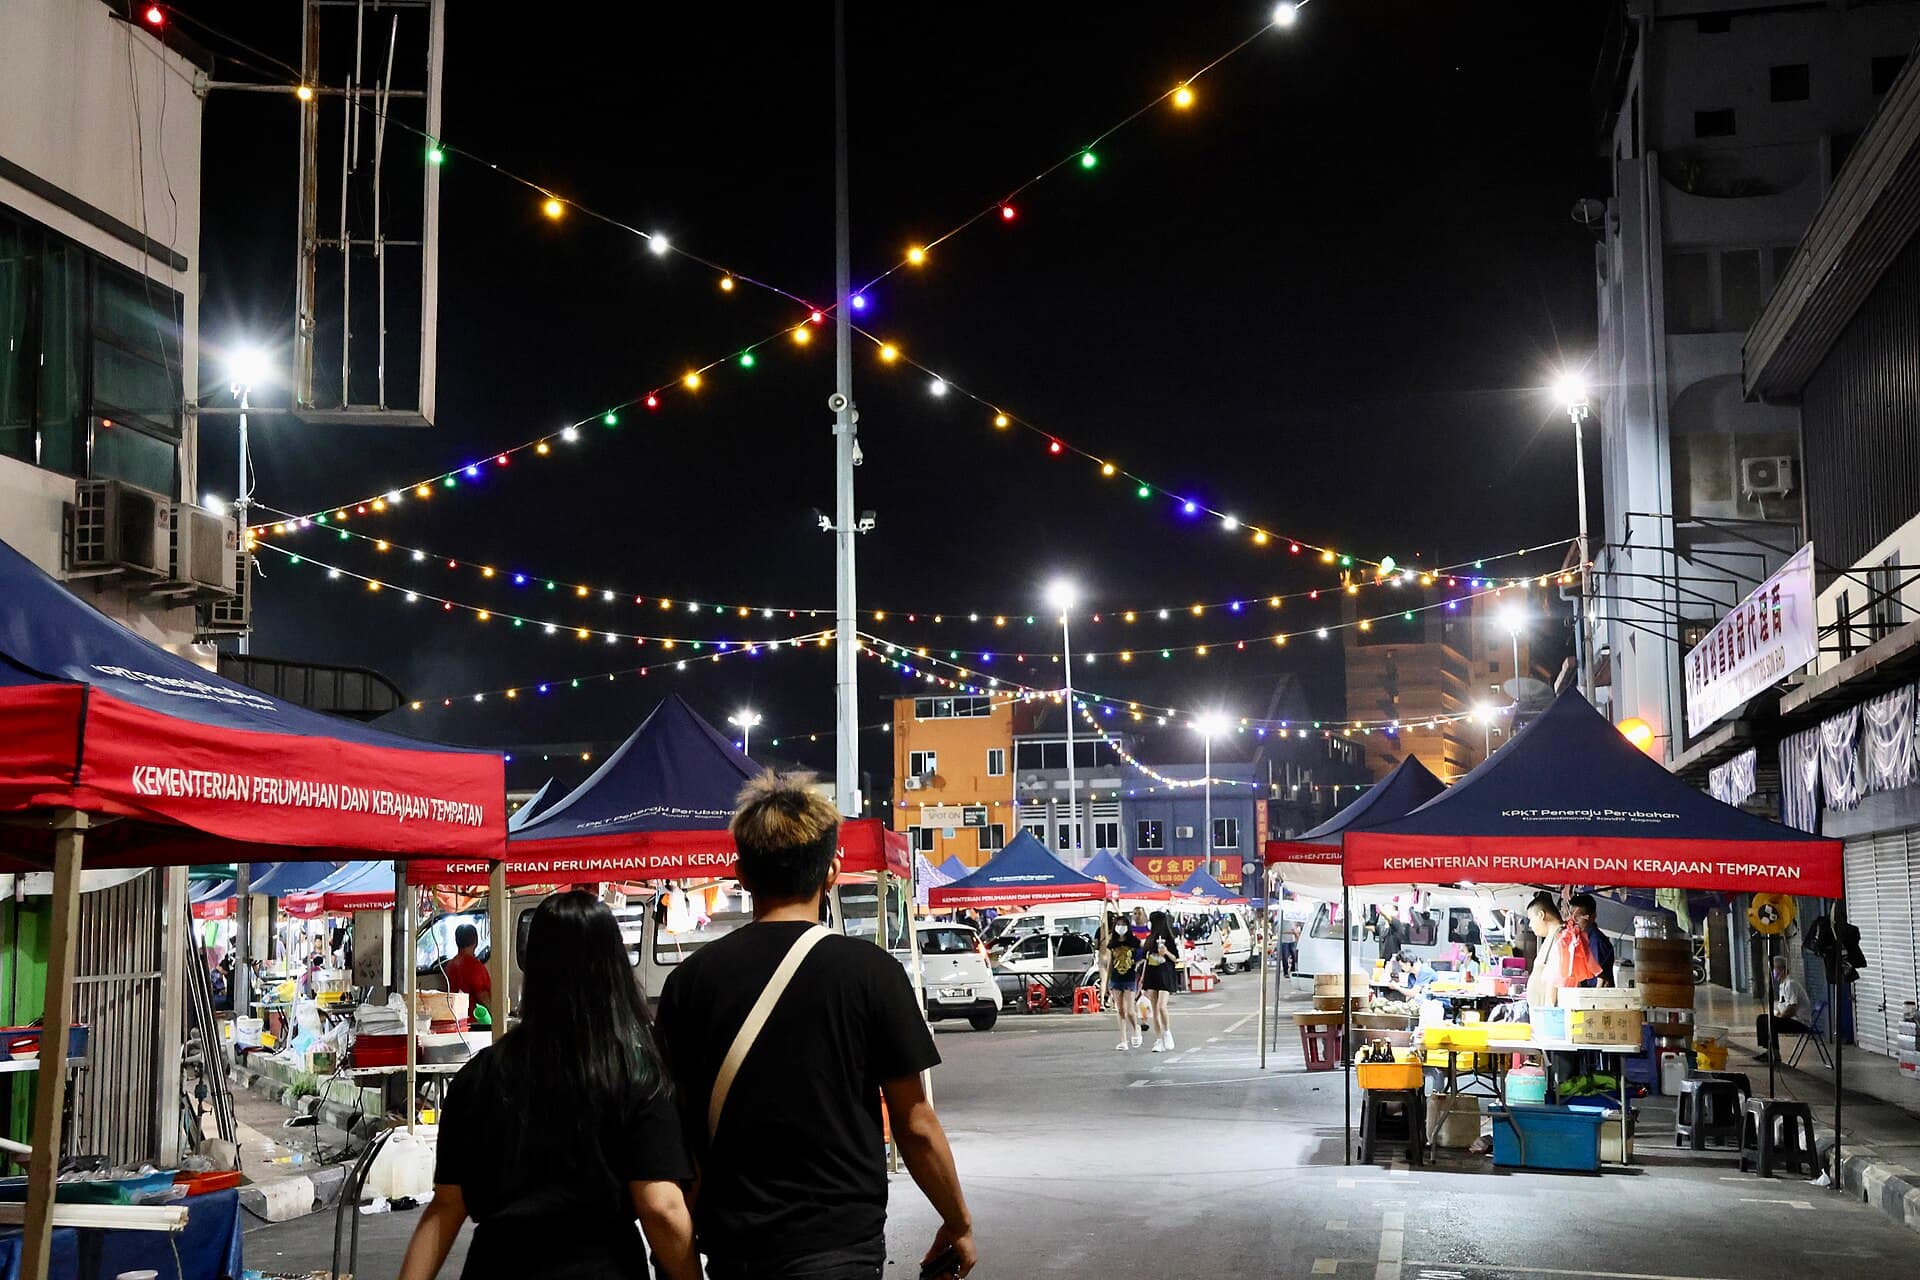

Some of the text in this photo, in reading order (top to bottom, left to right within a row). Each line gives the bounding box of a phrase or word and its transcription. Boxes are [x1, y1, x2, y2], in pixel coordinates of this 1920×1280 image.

[132, 765, 483, 827] KEMENTERIAN PERUMAHAN DAN KERAJAAN TEMPATAN
[613, 805, 669, 822] Peneraju
[671, 807, 738, 816] Perubaha
[1502, 809, 1680, 819] KPKT Peneraju Perubahan
[446, 852, 740, 873] KEMEERIAN PERUMAHAN DAN KERAJA
[1384, 855, 1800, 879] KEMENTERIAN PERUMAHAN DAN KERAJAAN TEMPATAN
